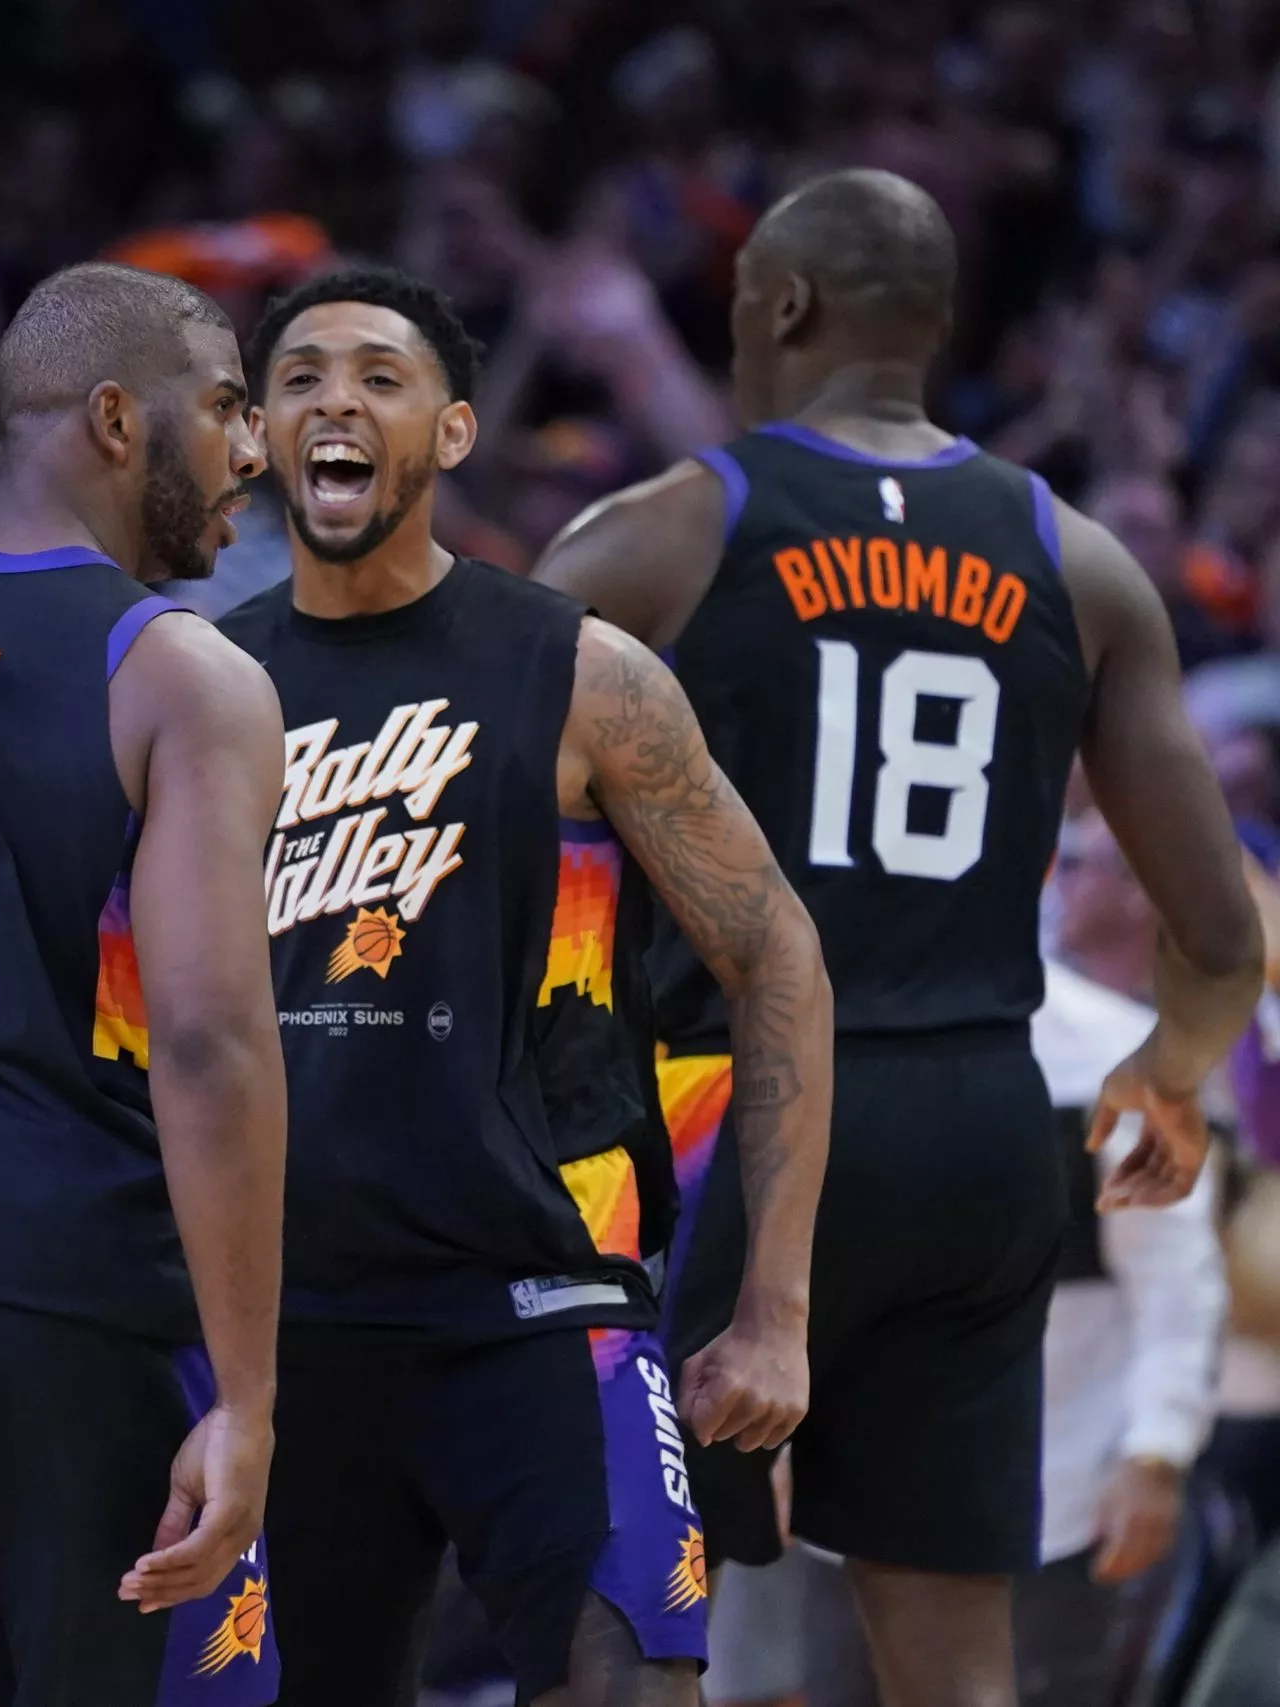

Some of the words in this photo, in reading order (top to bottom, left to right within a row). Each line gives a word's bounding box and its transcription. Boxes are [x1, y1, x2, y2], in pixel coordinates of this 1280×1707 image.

[772, 536, 1028, 644] BIYOMBO
[276, 698, 480, 829] Rally
[809, 638, 1001, 881] 18
[284, 832, 325, 862] THE
[278, 1010, 348, 1025] PHOENIX
[354, 1011, 404, 1025] SUNS
[328, 1026, 349, 1036] 2022
[636, 1356, 696, 1515] SUNS
